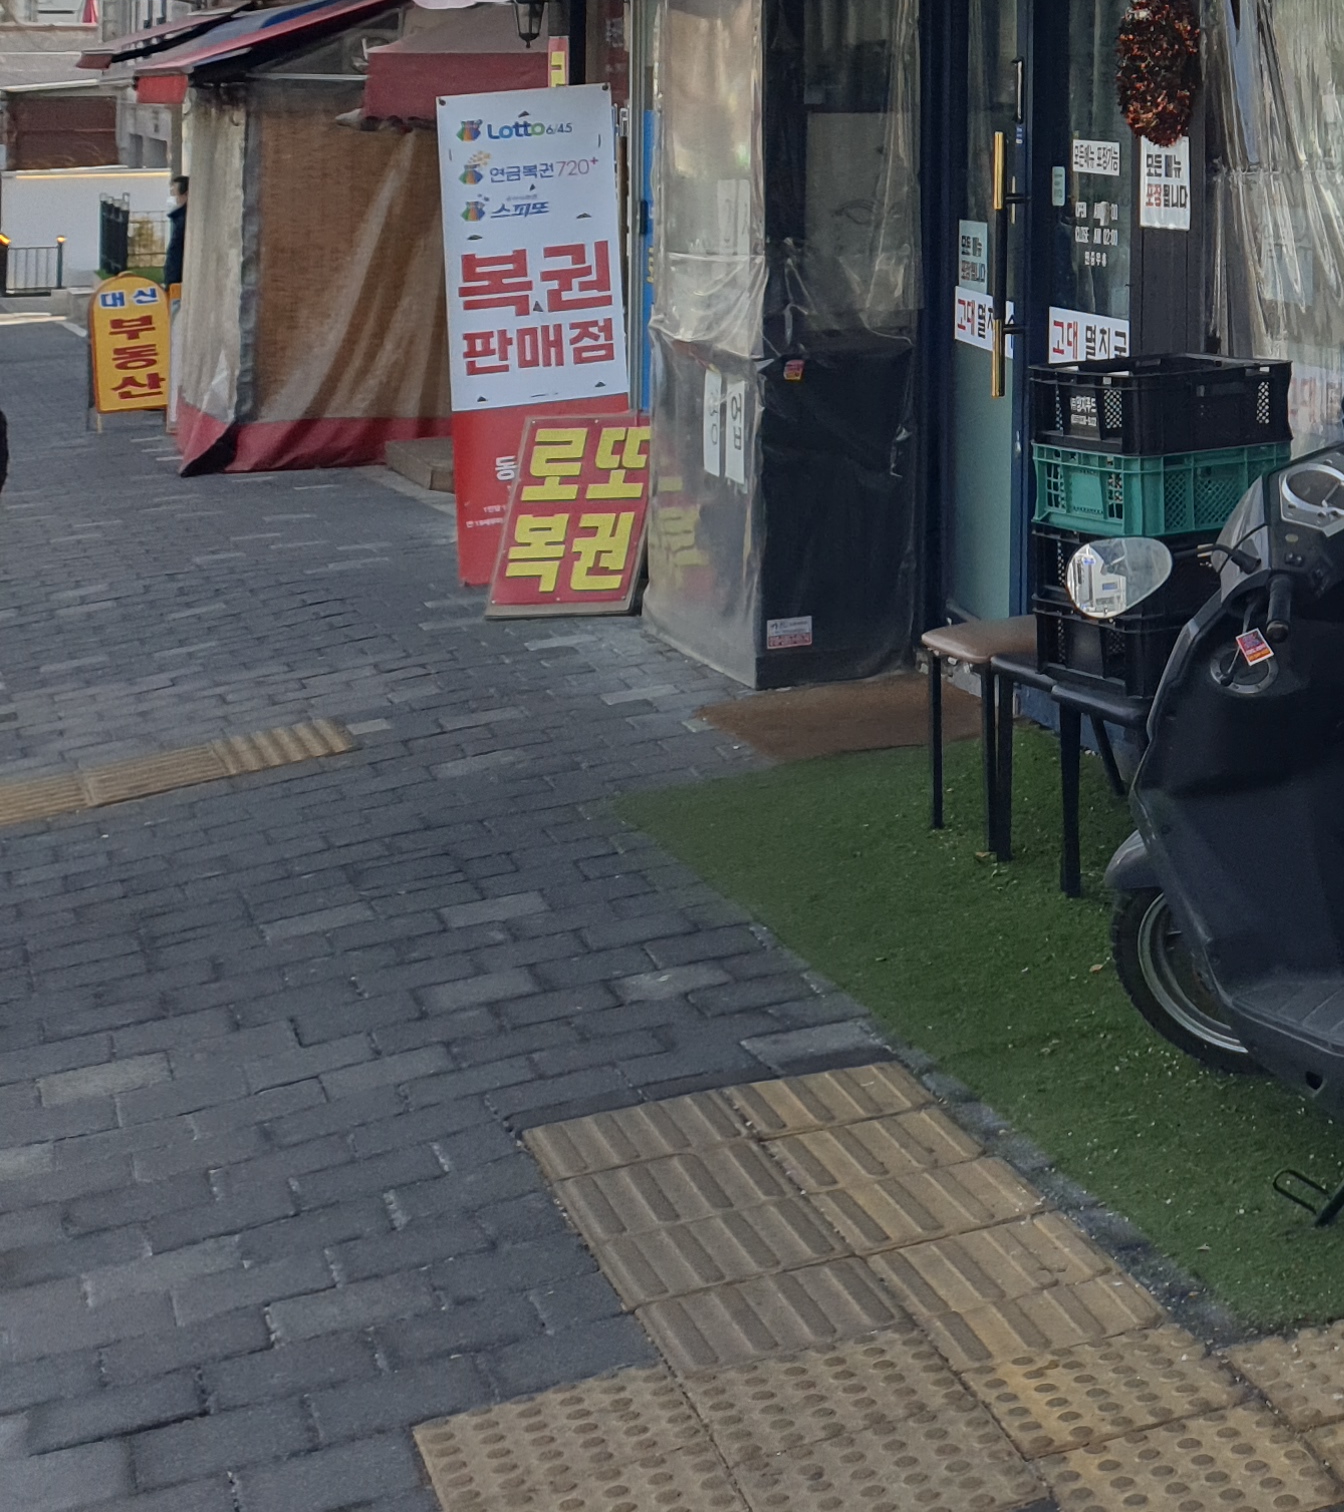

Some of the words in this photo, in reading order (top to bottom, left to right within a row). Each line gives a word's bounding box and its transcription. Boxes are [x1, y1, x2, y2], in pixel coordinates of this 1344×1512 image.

[1146, 153, 1162, 178] 모든
[100, 287, 158, 308] 대신
[458, 240, 613, 317] 복권
[462, 317, 615, 377] 판매점
[957, 298, 975, 336] 고대
[1052, 319, 1078, 360] 고대
[108, 314, 166, 400] 부동산
[520, 426, 650, 503] 로또
[505, 512, 635, 593] 복권
